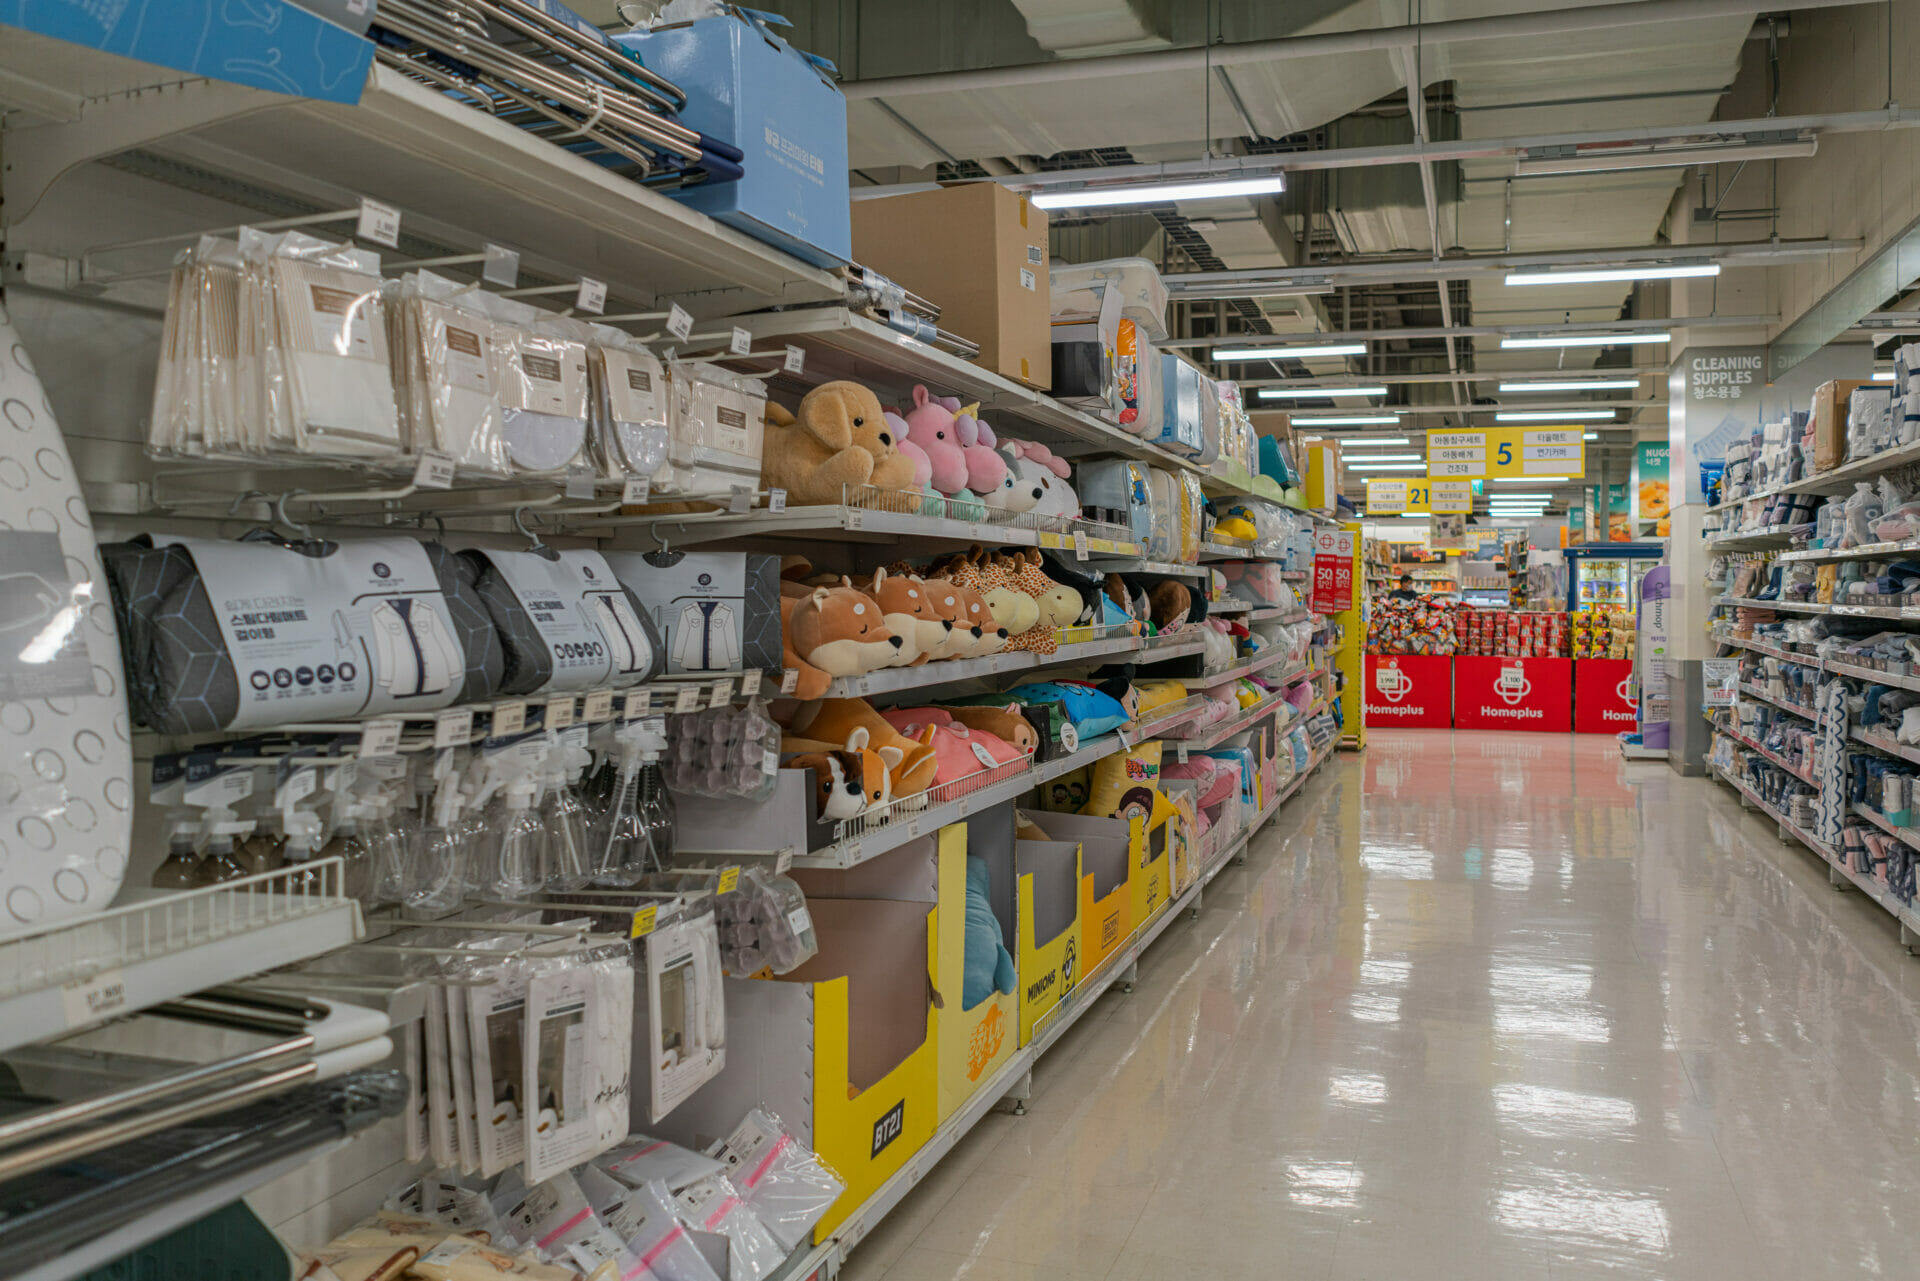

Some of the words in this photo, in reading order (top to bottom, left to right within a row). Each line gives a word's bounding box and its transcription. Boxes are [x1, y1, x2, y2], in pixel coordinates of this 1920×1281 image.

[1692, 356, 1762, 370] CLEANING
[1692, 371, 1752, 385] SUPPLES
[1693, 386, 1742, 399] 청소용품
[1497, 442, 1512, 465] 5
[1410, 488, 1429, 504] 21
[1317, 568, 1333, 580] 50
[1336, 569, 1350, 580] 50
[1364, 704, 1424, 717] Homeplus
[1481, 706, 1543, 720] Homeplus
[1027, 968, 1056, 1004] MINIONS
[874, 1107, 902, 1151] BT21
